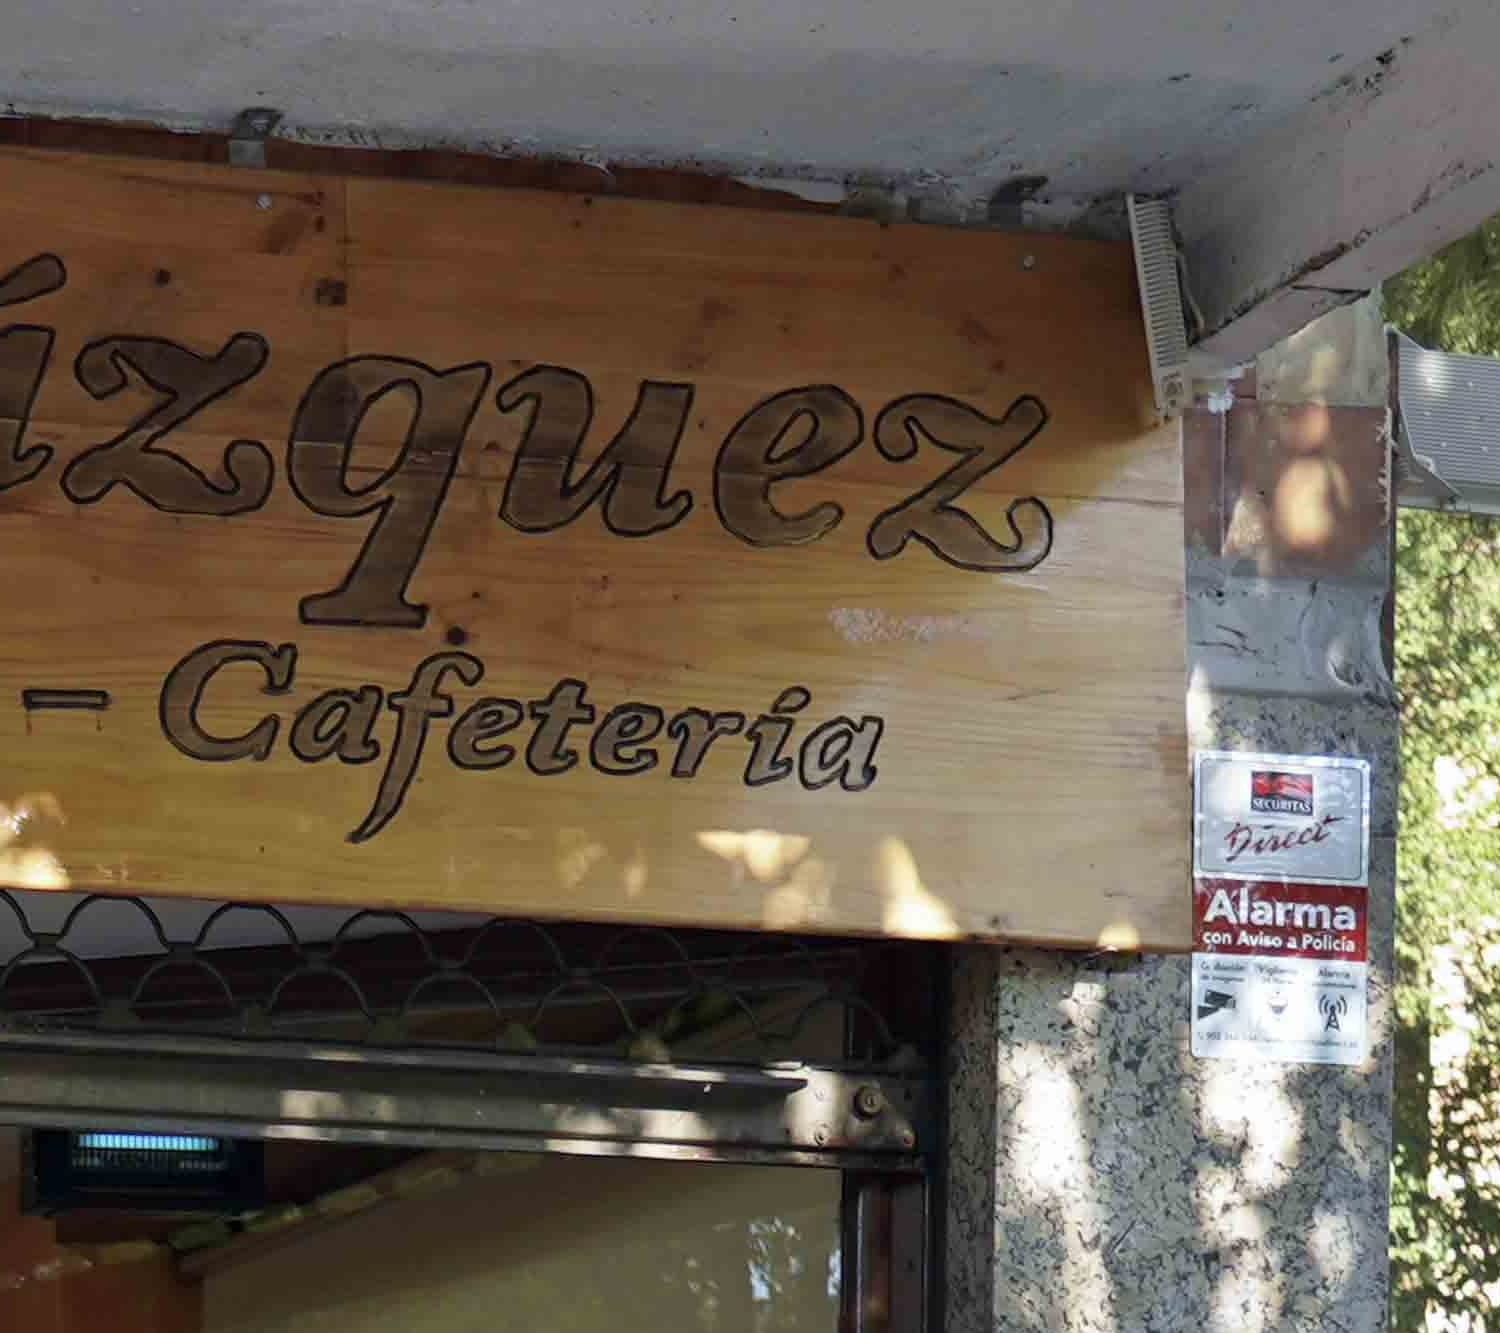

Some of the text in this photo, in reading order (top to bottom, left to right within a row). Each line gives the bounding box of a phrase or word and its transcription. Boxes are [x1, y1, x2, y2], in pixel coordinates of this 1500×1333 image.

[158, 637, 886, 845] Cafetería
[1252, 799, 1312, 814] SECURITAS
[1224, 813, 1346, 863] Direct
[1203, 887, 1357, 931] Alarma
[1202, 930, 1232, 945] con
[1236, 929, 1284, 949] Aviso
[1287, 935, 1298, 950] a
